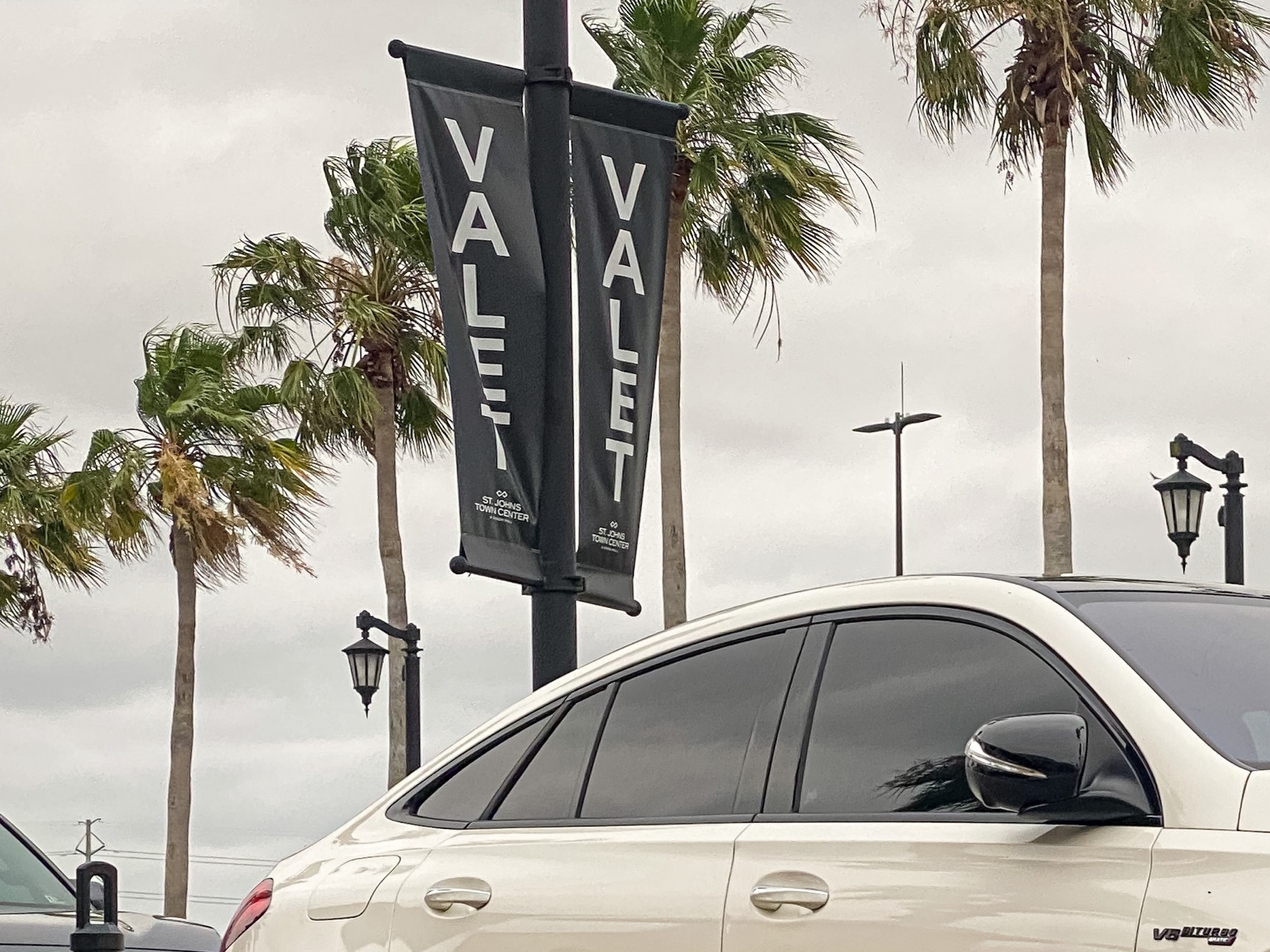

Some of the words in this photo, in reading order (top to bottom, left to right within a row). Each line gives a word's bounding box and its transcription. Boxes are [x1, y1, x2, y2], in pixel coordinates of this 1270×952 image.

[444, 117, 510, 470] VALET
[600, 154, 647, 502] VALET
[475, 503, 497, 514] TOWN
[497, 508, 529, 522] CENTER
[494, 499, 522, 511] JOHNS
[1181, 927, 1238, 937] BITURBO
